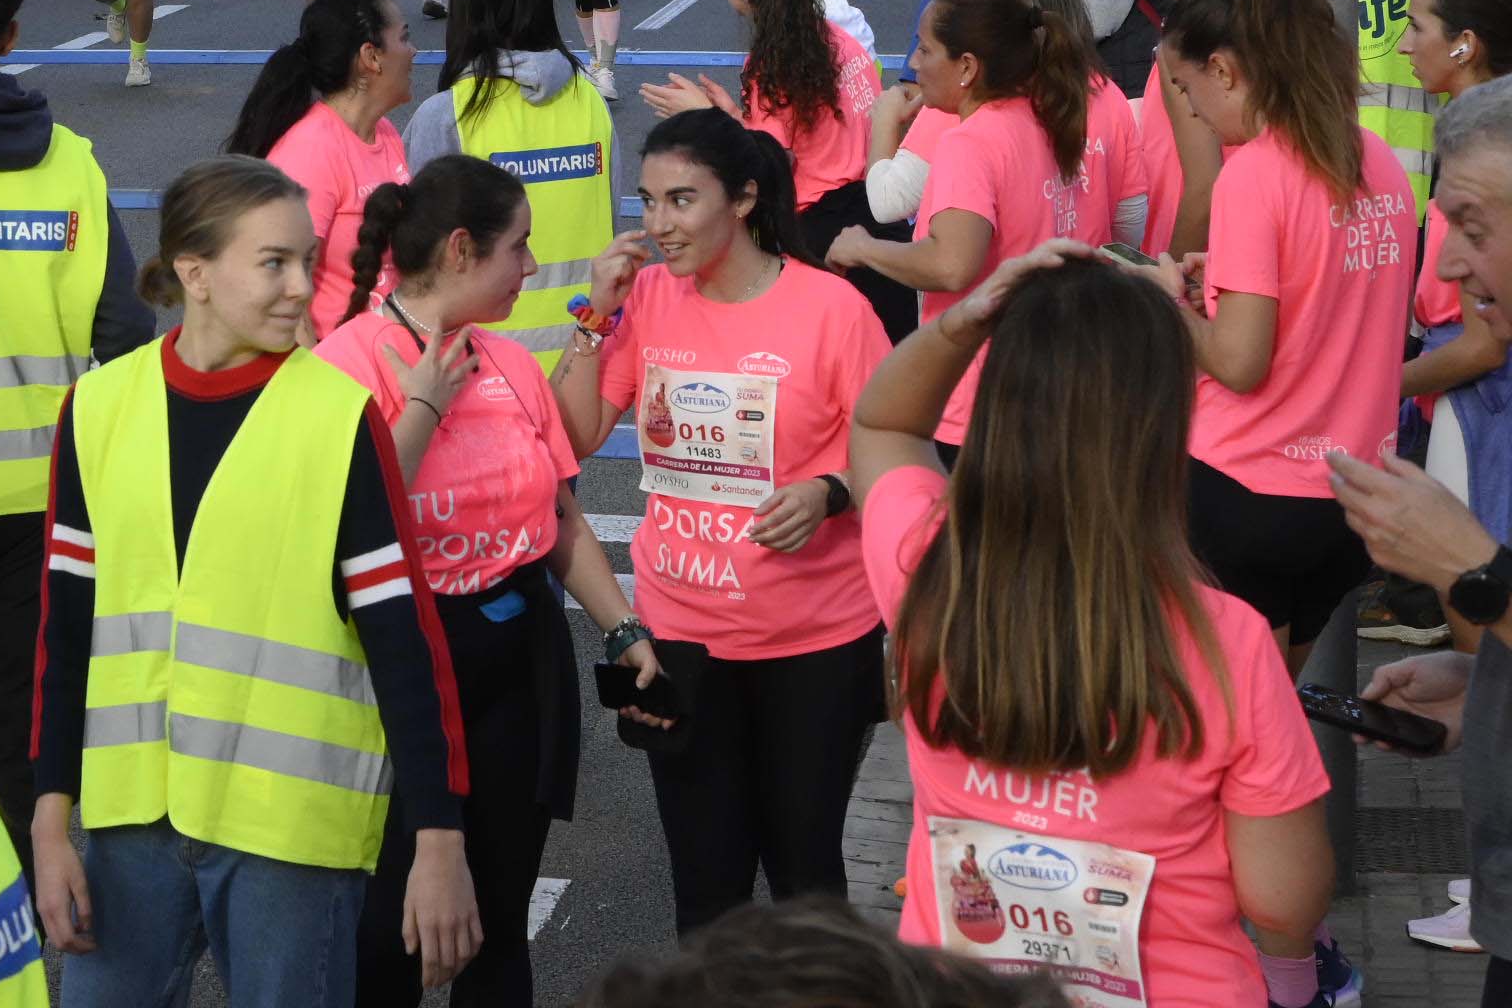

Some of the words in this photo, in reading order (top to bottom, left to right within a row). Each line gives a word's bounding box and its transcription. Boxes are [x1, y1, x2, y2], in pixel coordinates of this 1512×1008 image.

[1330, 192, 1406, 228] CARRERA
[1348, 223, 1371, 248] DE
[1374, 218, 1396, 241] LA
[643, 346, 696, 364] OYSHO
[675, 394, 726, 408] ASTURIANA
[736, 393, 764, 401] SUMA
[679, 423, 725, 442] 016
[686, 446, 722, 459] 11483
[656, 457, 688, 468] CARRERA
[714, 466, 740, 474] MUJER
[743, 469, 761, 477] 2023
[654, 473, 688, 489] OYSHO
[722, 484, 763, 497] Santander
[409, 489, 455, 524] TU
[654, 543, 741, 590] SUMA
[727, 592, 746, 601] 2023
[964, 764, 1099, 823] MUJER
[1012, 810, 1048, 830] 2023
[996, 861, 1070, 884] ASTURIANA
[1088, 863, 1135, 880] SUMA
[1009, 903, 1074, 936] 016
[1022, 939, 1072, 961] 29371
